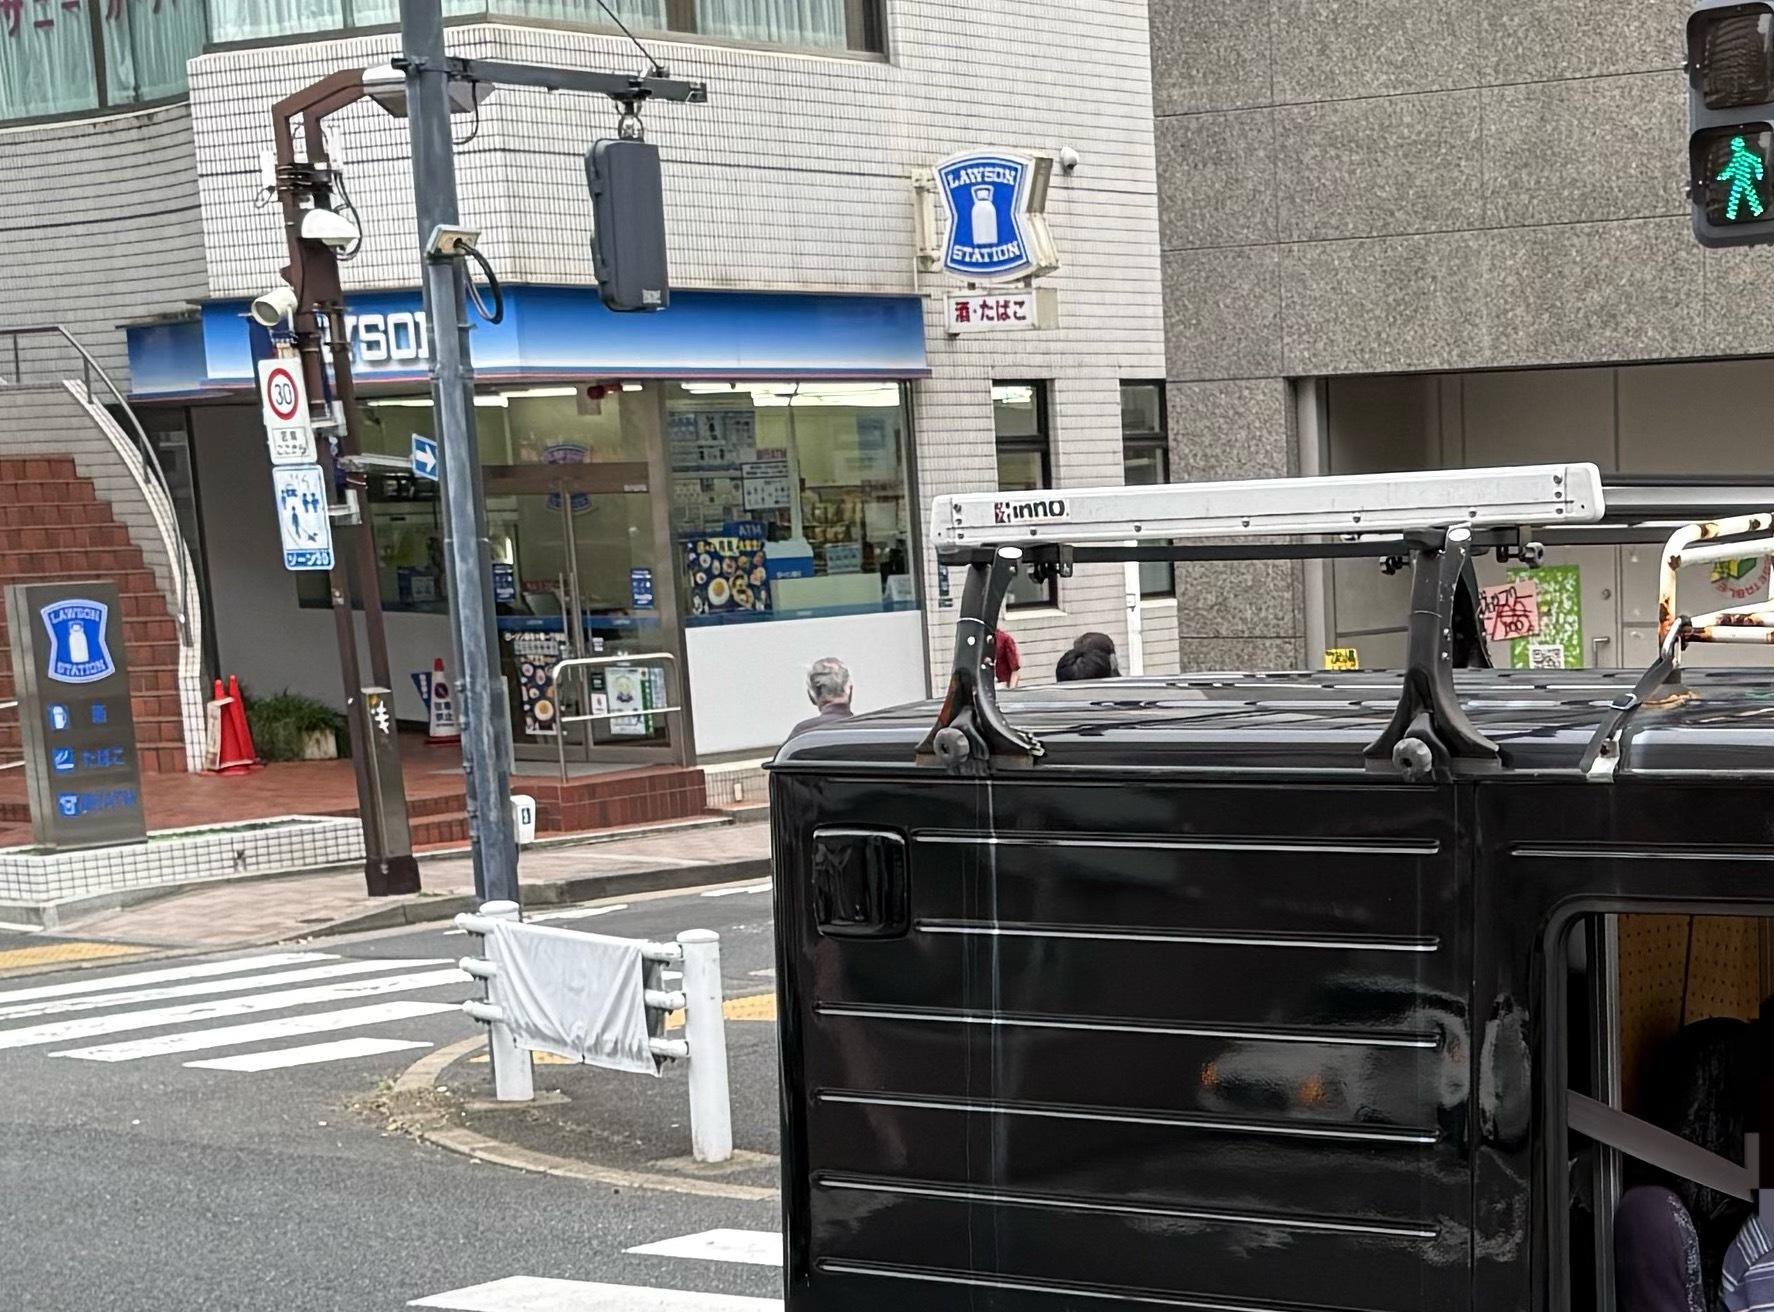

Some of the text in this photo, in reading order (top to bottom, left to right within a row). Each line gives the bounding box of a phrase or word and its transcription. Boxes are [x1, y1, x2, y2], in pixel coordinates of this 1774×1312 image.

[947, 167, 1017, 188] LAWSON
[952, 240, 1022, 263] STATION
[955, 299, 1027, 323] 酒・たばこ
[274, 382, 293, 406] 30
[1012, 499, 1066, 519] inno
[738, 524, 762, 537] ATM
[50, 607, 101, 625] LAWSON
[56, 659, 107, 677] STATION
